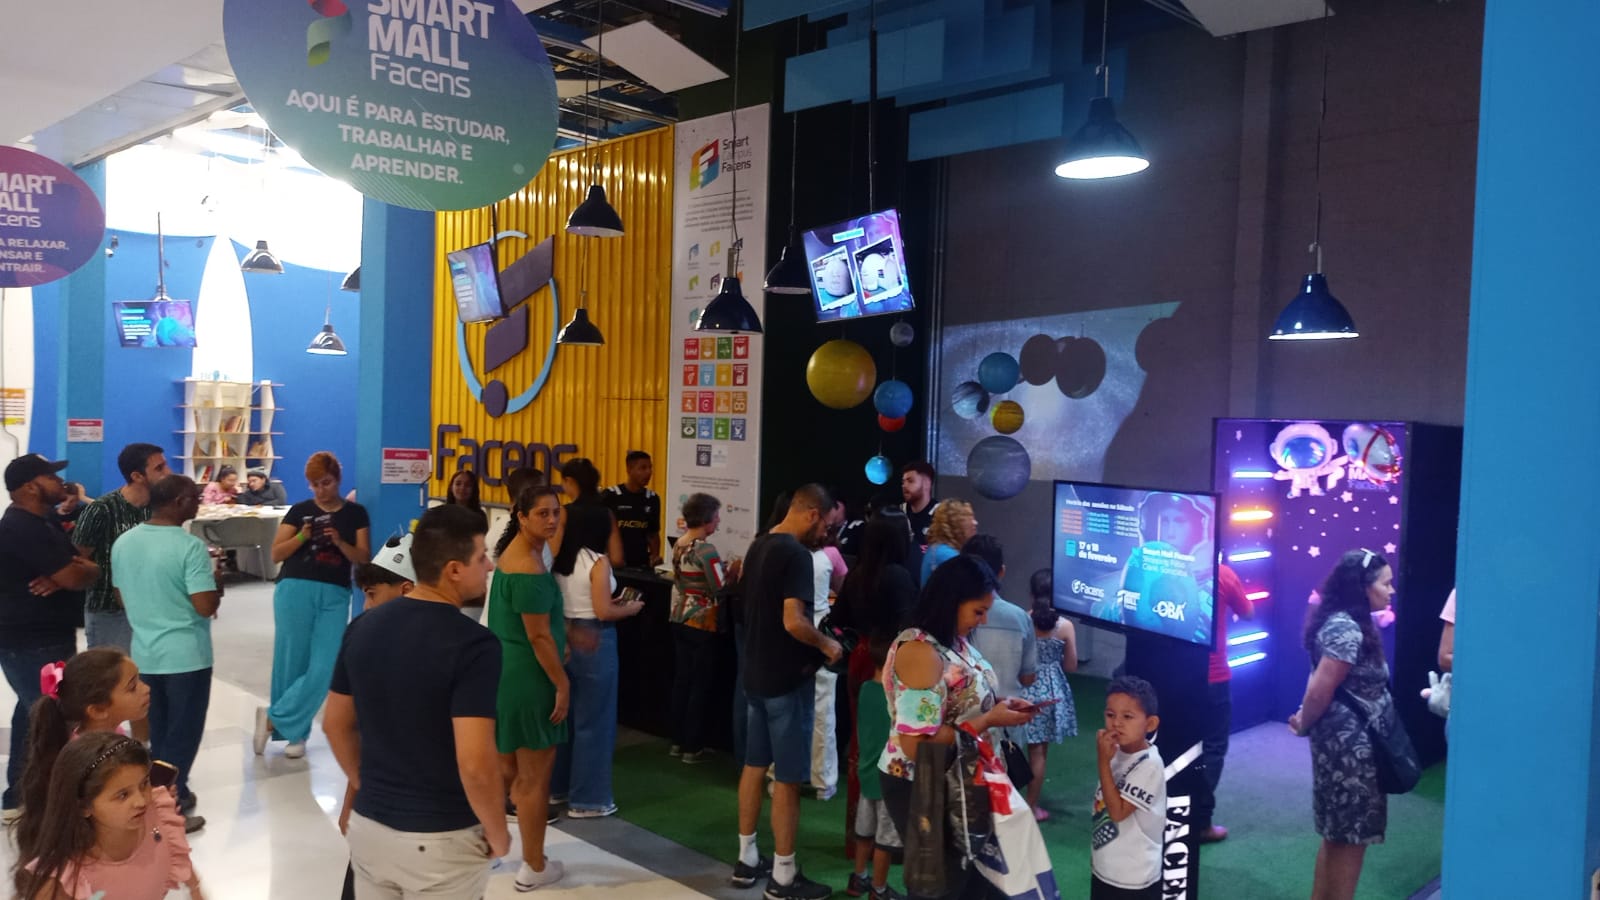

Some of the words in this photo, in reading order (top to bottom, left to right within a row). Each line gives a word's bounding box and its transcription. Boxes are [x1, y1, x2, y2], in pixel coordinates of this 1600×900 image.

[368, 14, 470, 70] MALL
[370, 52, 471, 98] Facens
[286, 88, 342, 114] AQUI
[345, 95, 359, 118] É
[364, 102, 417, 127] PARA
[421, 113, 511, 146] ESTUDAR,
[338, 123, 457, 159] TRABALHAR
[461, 143, 473, 162] E
[350, 152, 464, 185] APRENDER.
[35, 252, 43, 260] E
